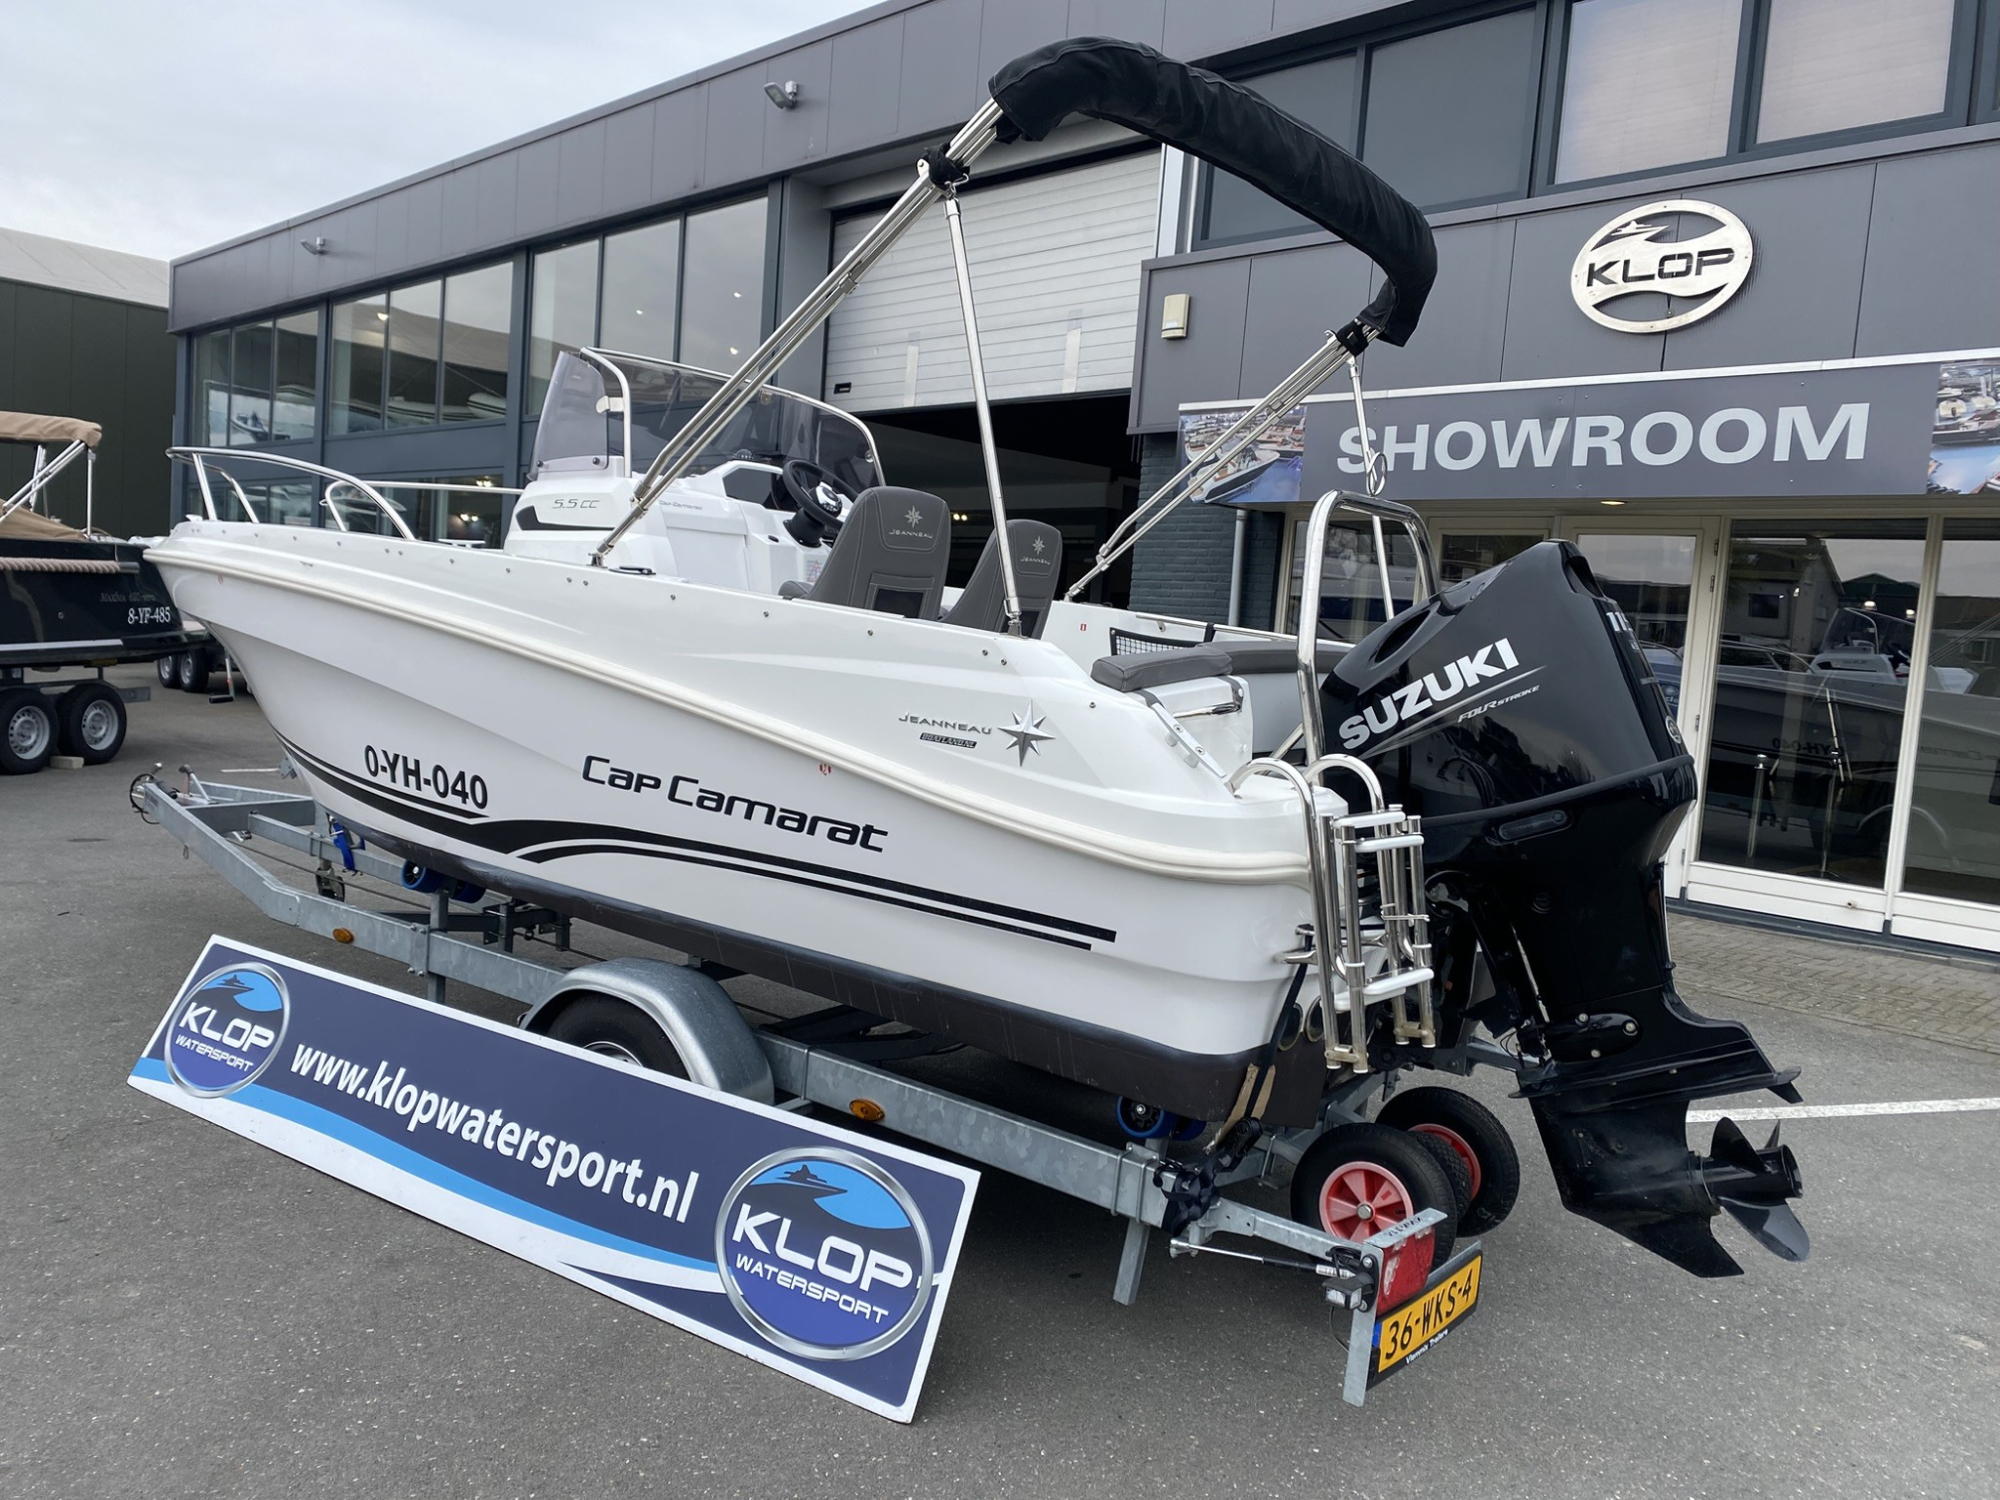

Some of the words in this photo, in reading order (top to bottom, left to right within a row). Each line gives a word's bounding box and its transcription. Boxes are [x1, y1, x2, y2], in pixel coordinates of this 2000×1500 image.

[1586, 247, 1735, 287] KLOP
[1337, 402, 1870, 474] SHOWROOM
[552, 498, 579, 509] 5.5
[888, 528, 934, 539] JEANNEAU
[1020, 555, 1051, 565] JEANNEAU
[127, 606, 171, 625] 8-YF-485
[1338, 637, 1520, 750] SUZUKI
[898, 711, 993, 735] JEANNEAU
[364, 744, 488, 810] 0-YH-040
[581, 755, 662, 793] Cap
[667, 774, 889, 853] Camarat
[175, 1034, 254, 1072] WATERSPORT
[178, 1001, 275, 1052] KLOP
[289, 1042, 700, 1224] www.klopwatersport.nl
[731, 1202, 913, 1292] KLOP
[735, 1253, 889, 1324] WATERSPORT
[1385, 1268, 1473, 1360] 36-WKS-4
